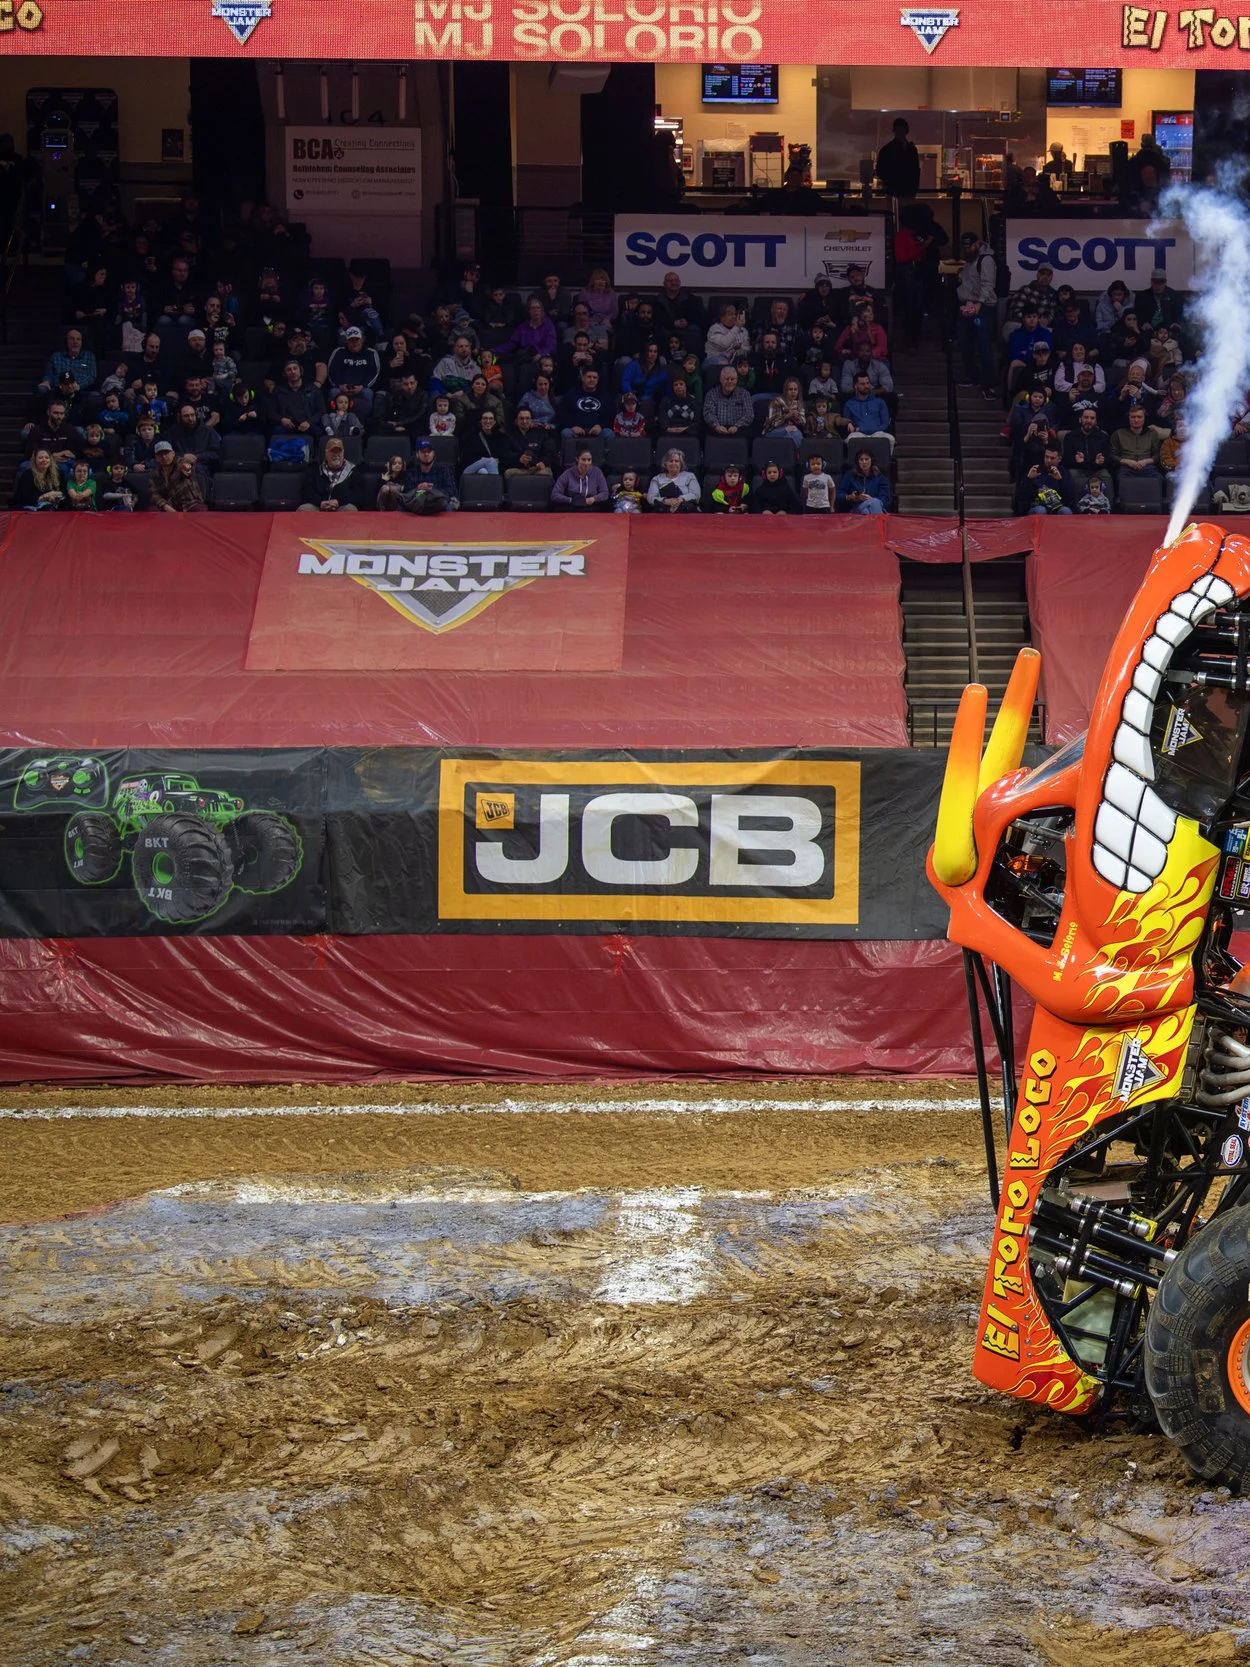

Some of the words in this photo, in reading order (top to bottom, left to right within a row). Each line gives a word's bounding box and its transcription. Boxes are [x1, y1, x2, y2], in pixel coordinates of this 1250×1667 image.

[211, 7, 271, 17] MONSTER
[228, 16, 256, 26] JAM
[900, 16, 960, 27] MONSTER
[414, 22, 492, 56] MJ
[512, 23, 763, 61] SOLORIO
[916, 26, 944, 36] JAM
[293, 138, 334, 160] BCA
[625, 231, 786, 268] SCOTT
[1017, 237, 1176, 271] SCOTT
[297, 554, 587, 576] MONSTER
[377, 577, 505, 592] JAM
[1168, 707, 1186, 756] MONSTER
[1178, 721, 1190, 746] JAM
[485, 801, 509, 818] JCB
[145, 838, 169, 848] BKT
[475, 793, 825, 886] JCB
[148, 887, 173, 900] BKT
[1120, 1037, 1142, 1103] MONSTER
[1134, 1055, 1149, 1087] JAM
[1009, 1047, 1057, 1170] Loco
[1239, 1097, 1250, 1128] SYSTEM
[992, 1179, 1029, 1298] Toro
